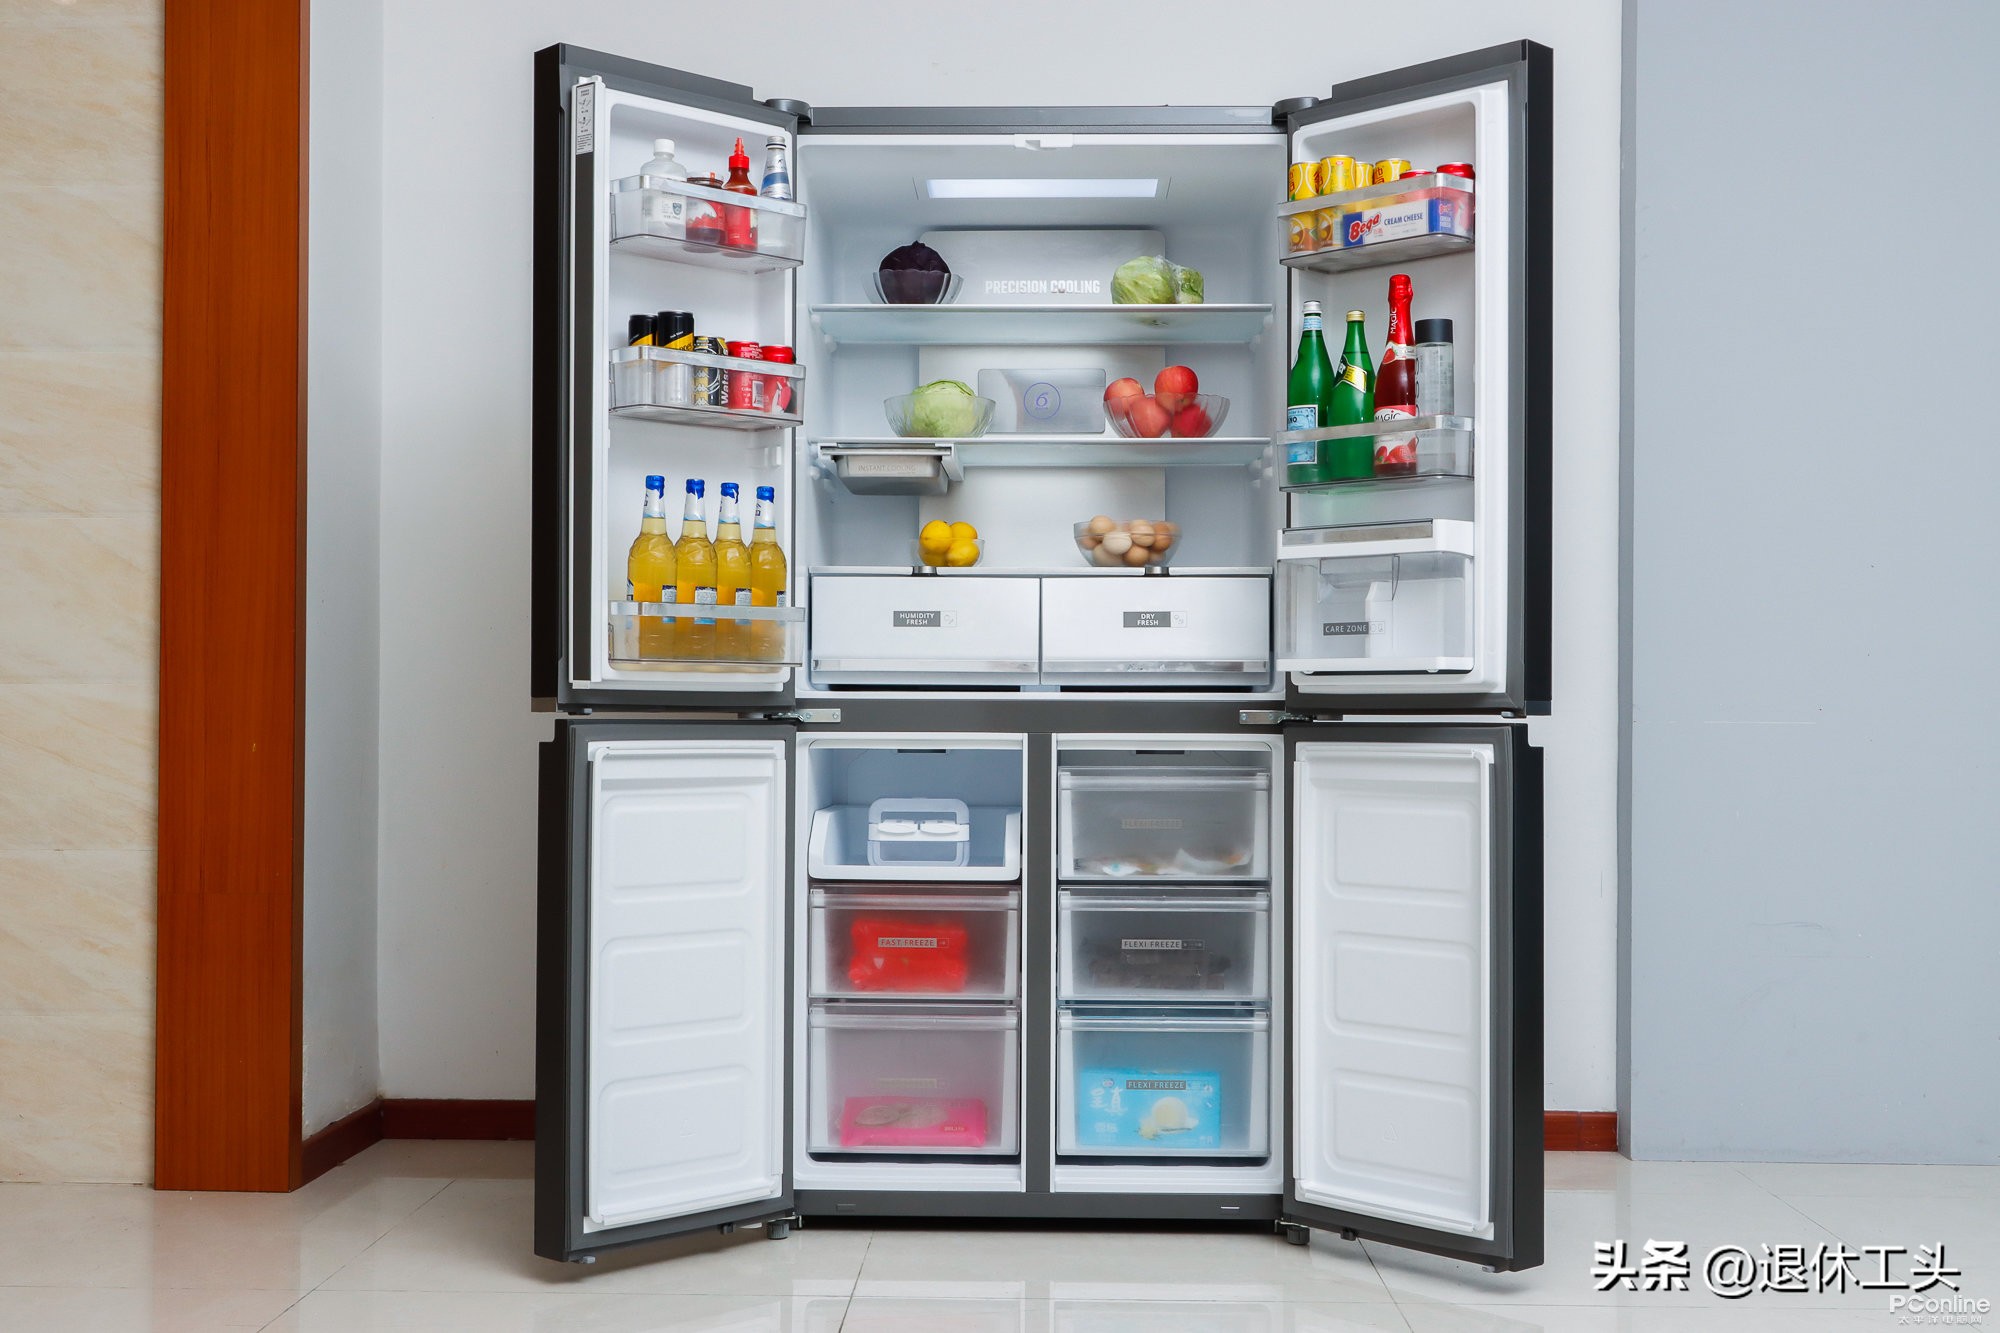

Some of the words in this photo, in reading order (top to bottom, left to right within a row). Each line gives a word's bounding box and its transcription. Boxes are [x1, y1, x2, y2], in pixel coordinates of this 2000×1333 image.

[1384, 216, 1403, 226] CREAM
[1403, 213, 1424, 223] CHEESE
[1349, 212, 1382, 242] Bega
[985, 279, 1047, 294] PRECISION
[1050, 279, 1100, 294] COOLING
[1325, 625, 1345, 633] CARE
[1346, 624, 1368, 632] ZONE
[1124, 940, 1147, 948] FLEXI
[1150, 940, 1180, 948] FREEZE
[1128, 1081, 1151, 1089] FLEXI
[1154, 1081, 1185, 1089] FREEZE
